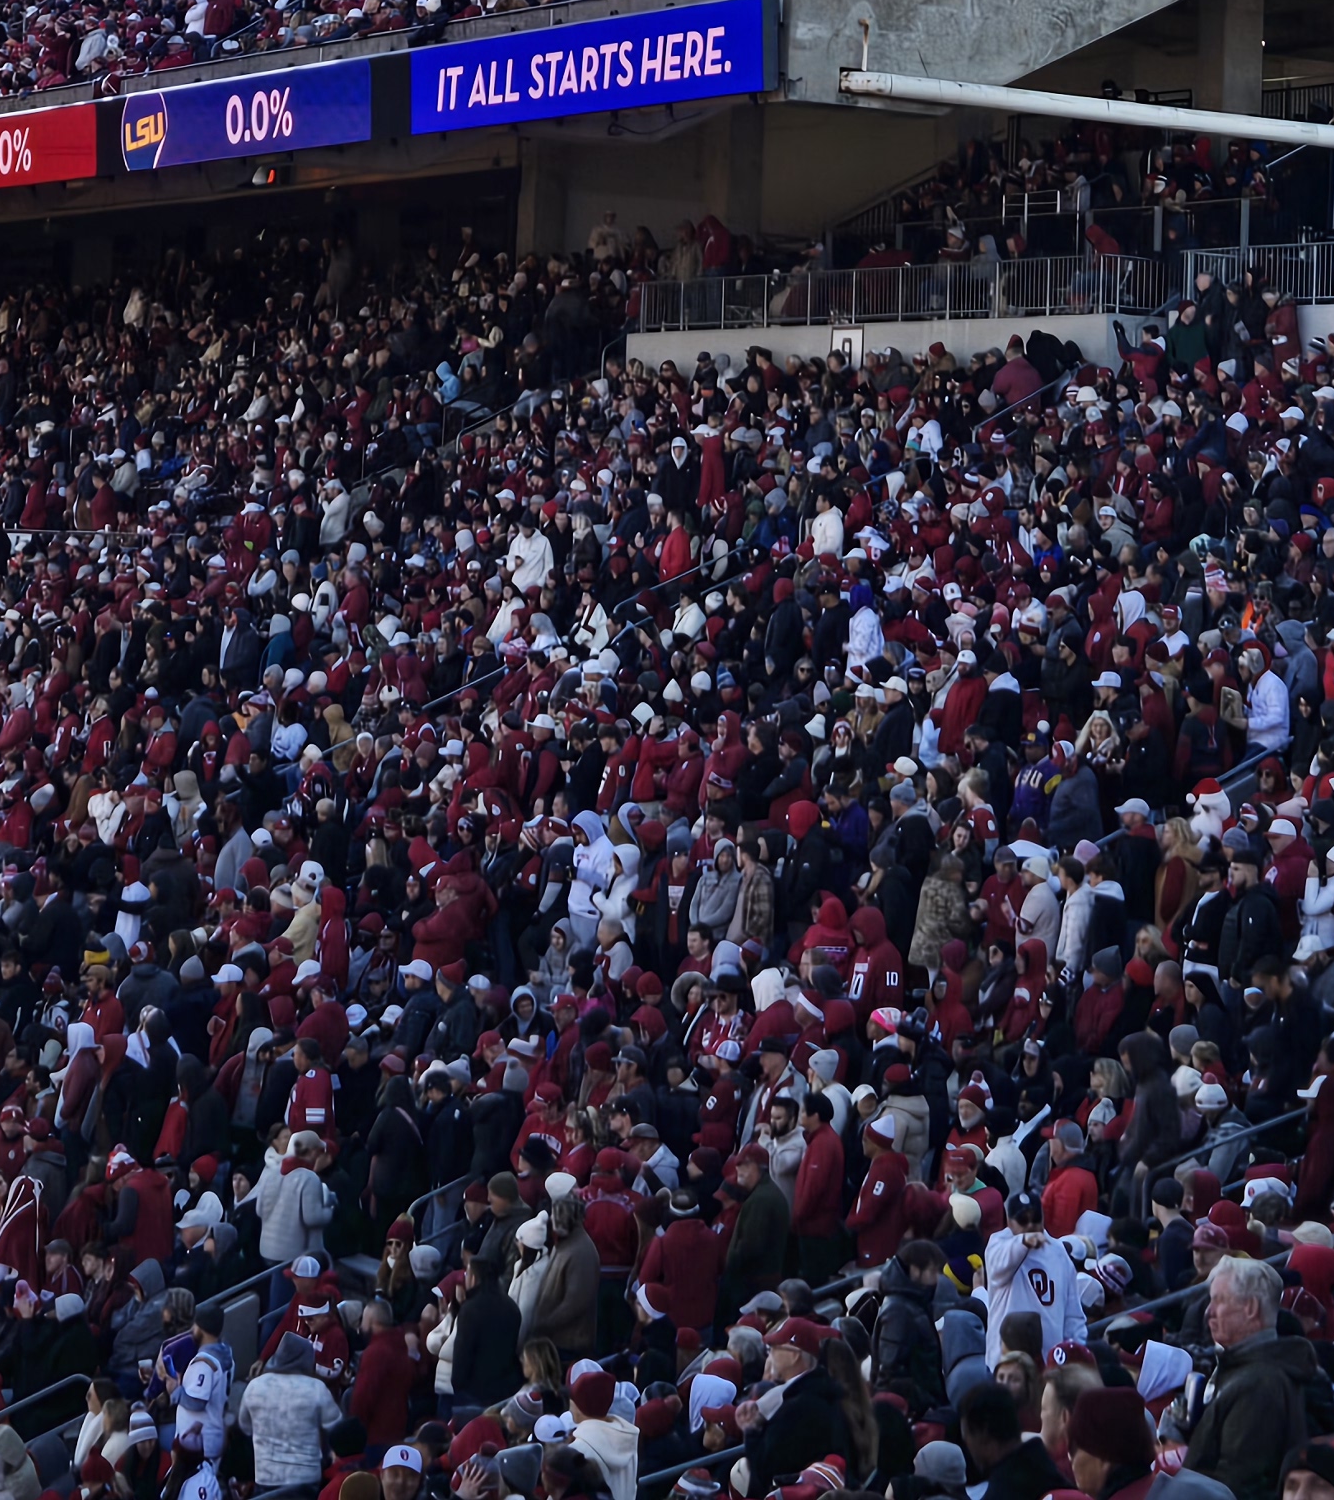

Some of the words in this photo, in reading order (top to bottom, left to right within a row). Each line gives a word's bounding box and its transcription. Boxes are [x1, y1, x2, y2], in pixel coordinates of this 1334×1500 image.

[436, 66, 464, 112] IT
[468, 58, 520, 108] ALL
[528, 40, 634, 100] STARTS
[640, 26, 732, 85] HERE.
[125, 112, 165, 151] LSU
[225, 86, 294, 145] 0.0%
